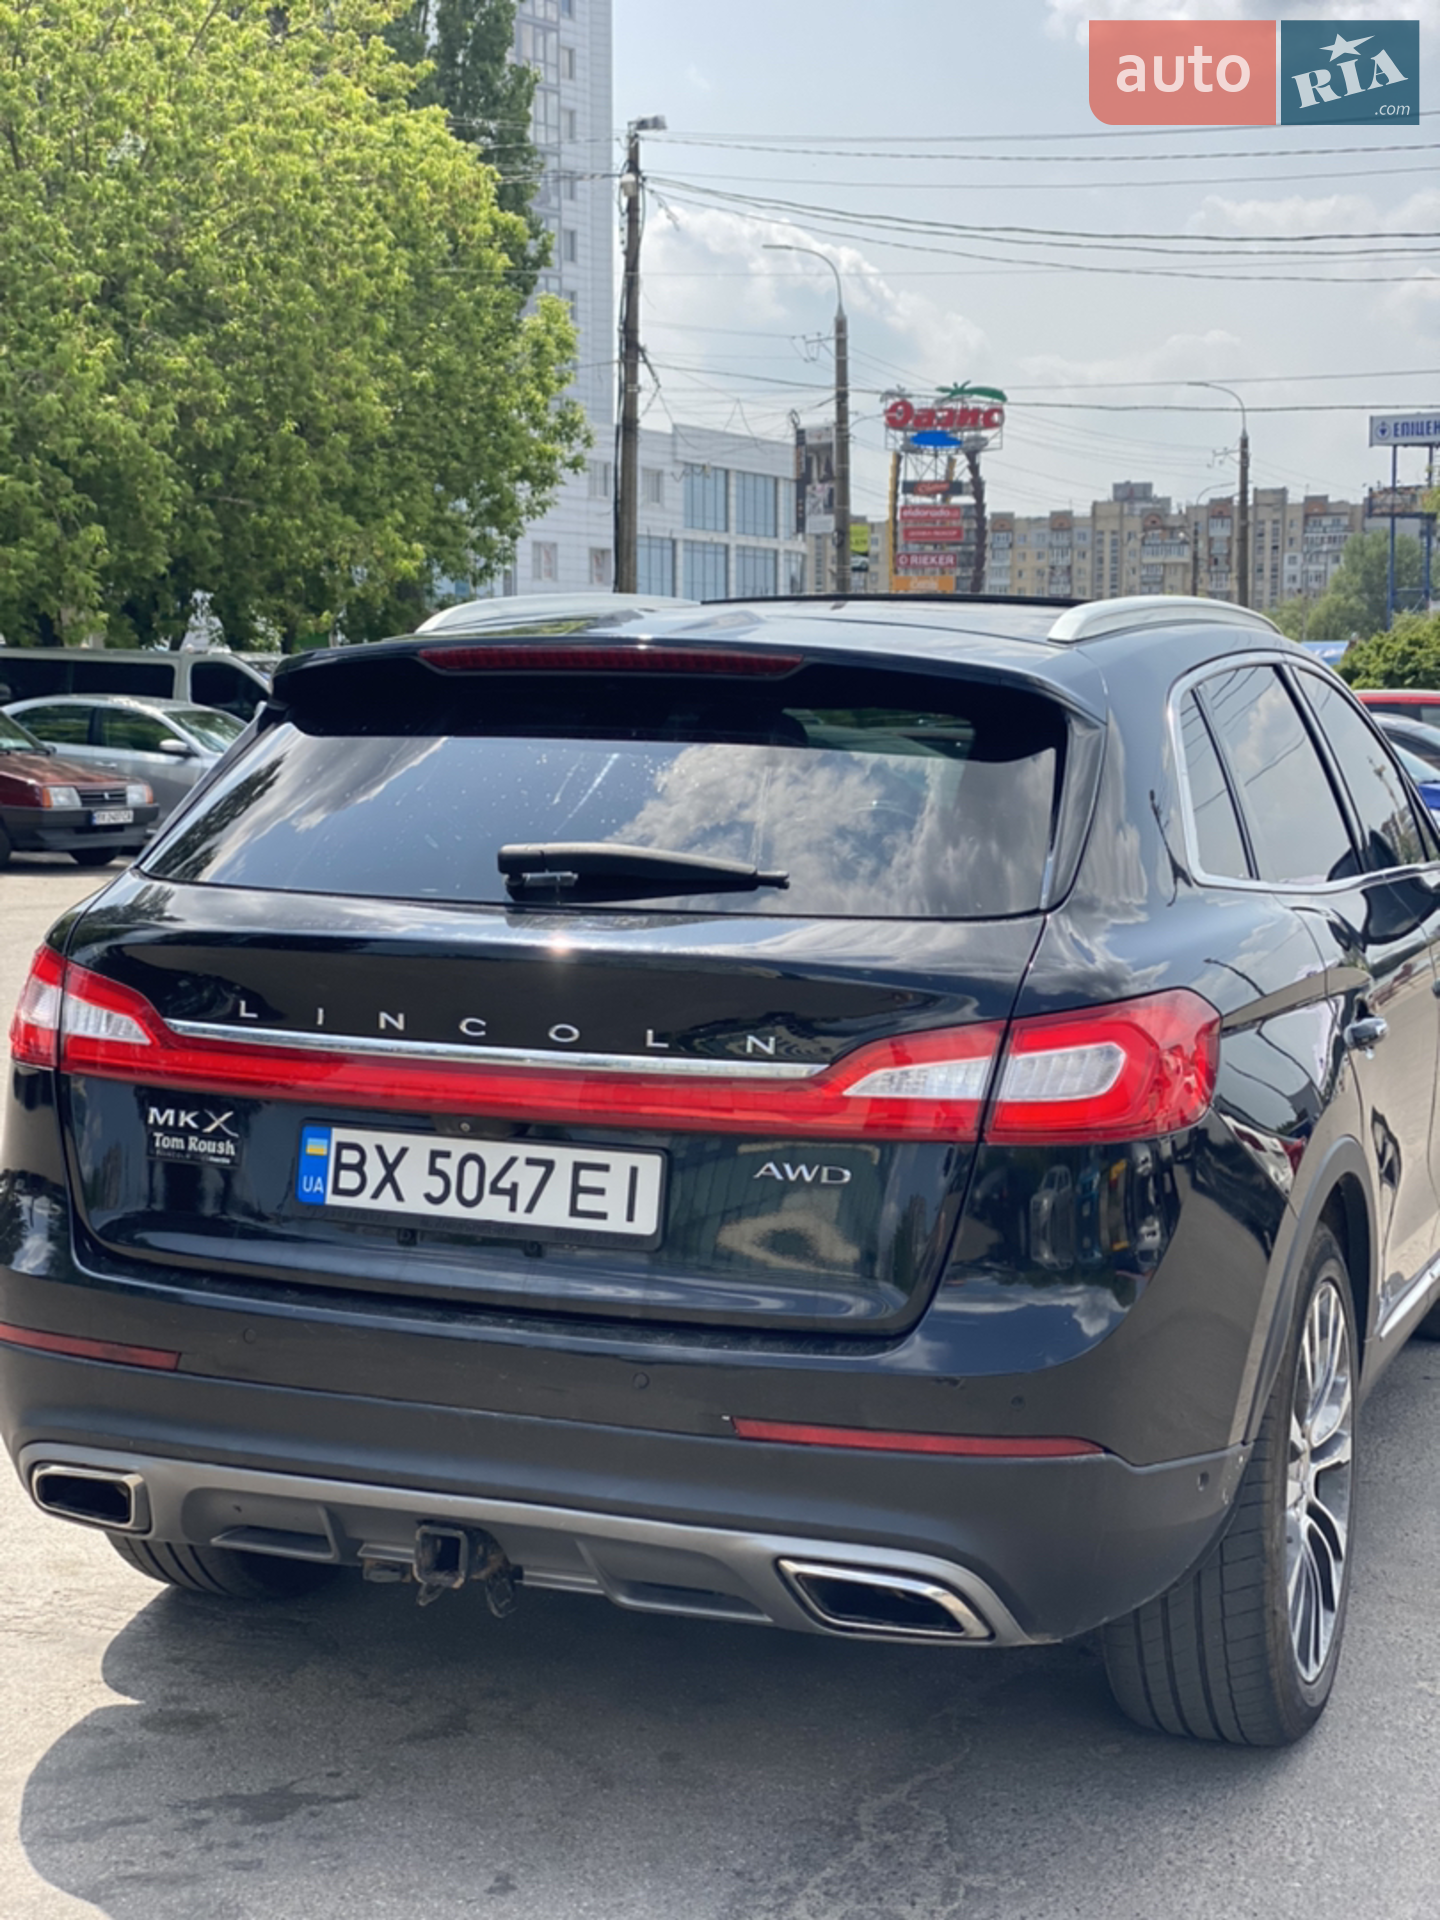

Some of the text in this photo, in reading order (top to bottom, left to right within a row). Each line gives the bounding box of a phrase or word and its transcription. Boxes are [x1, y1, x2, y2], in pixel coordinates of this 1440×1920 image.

[910, 554, 954, 566] RIEKER
[239, 1000, 775, 1055] LINCOLN
[153, 1132, 185, 1150] Tom
[188, 1136, 235, 1156] Roush
[302, 1175, 324, 1194] UA
[331, 1141, 639, 1222] BX 5047 EI
[753, 1162, 851, 1184] AWD
